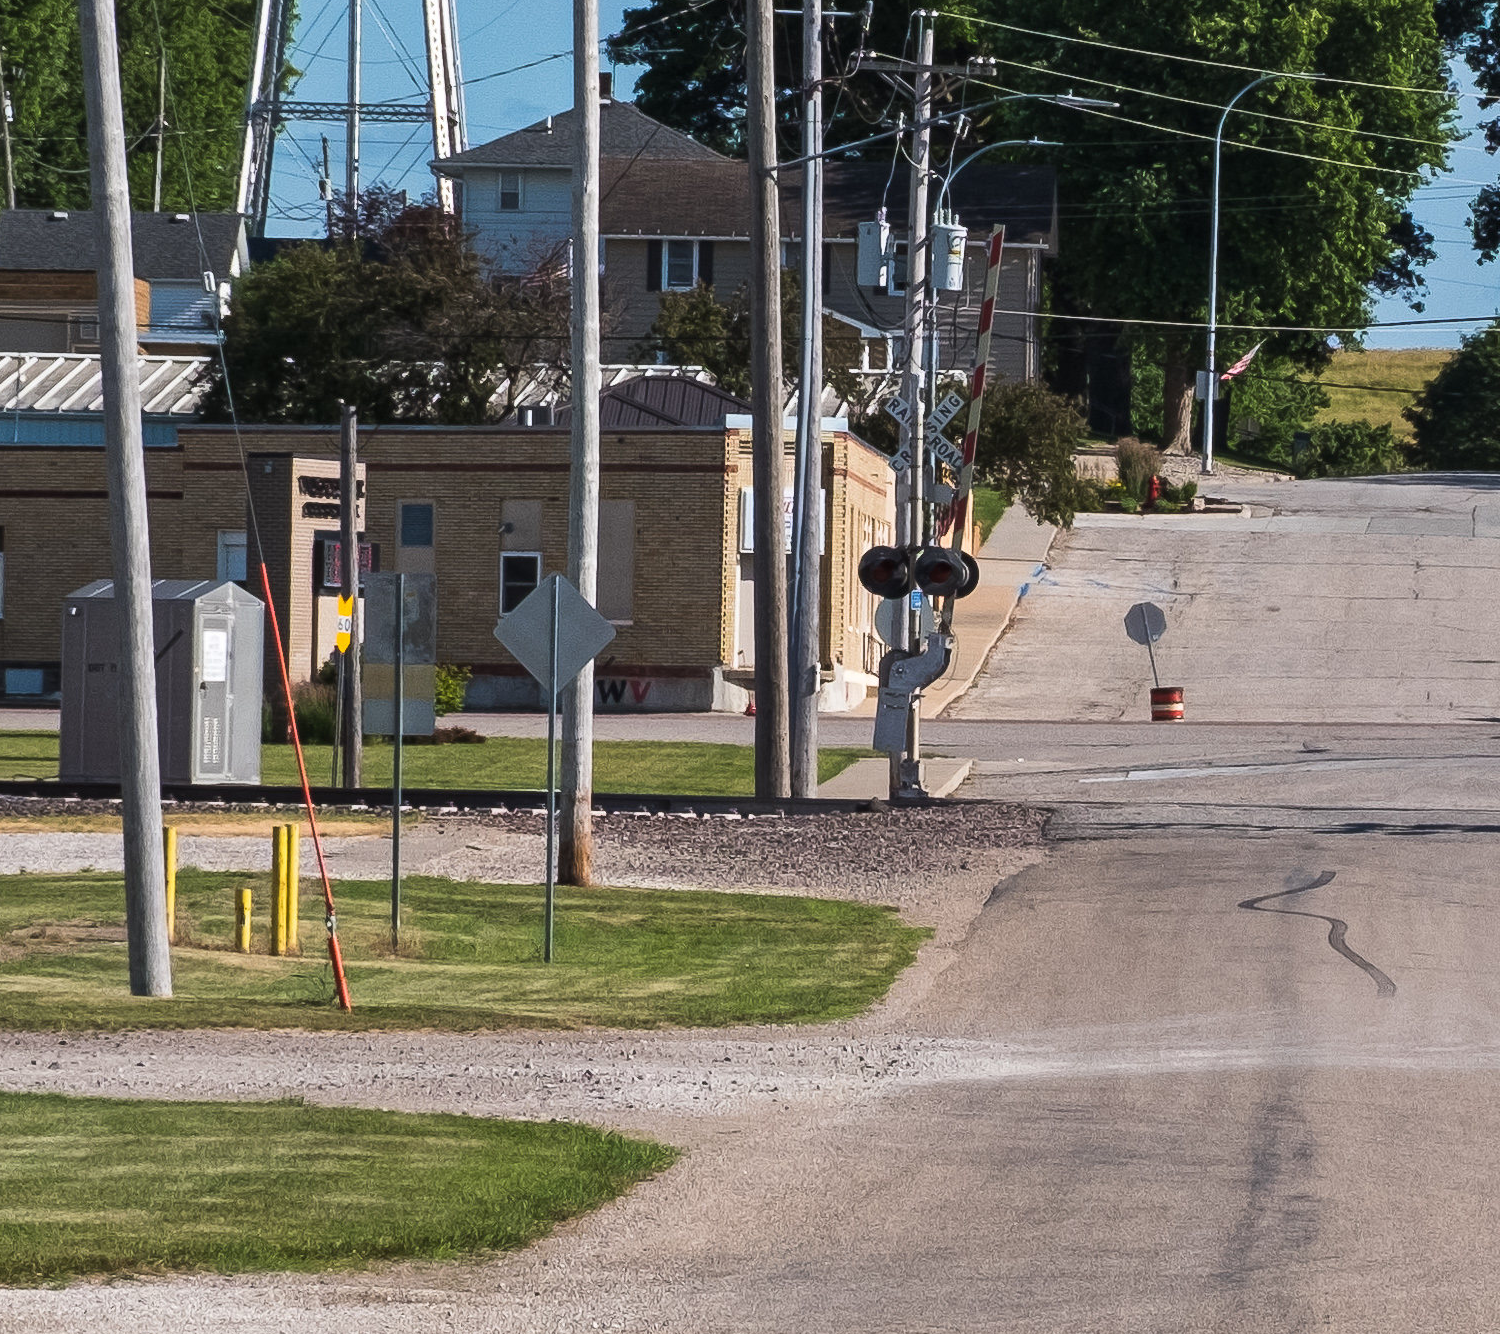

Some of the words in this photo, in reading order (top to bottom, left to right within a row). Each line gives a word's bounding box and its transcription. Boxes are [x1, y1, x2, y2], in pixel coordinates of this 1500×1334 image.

[888, 398, 912, 424] RAI
[892, 395, 960, 472] CRSING
[338, 618, 351, 631] 60
